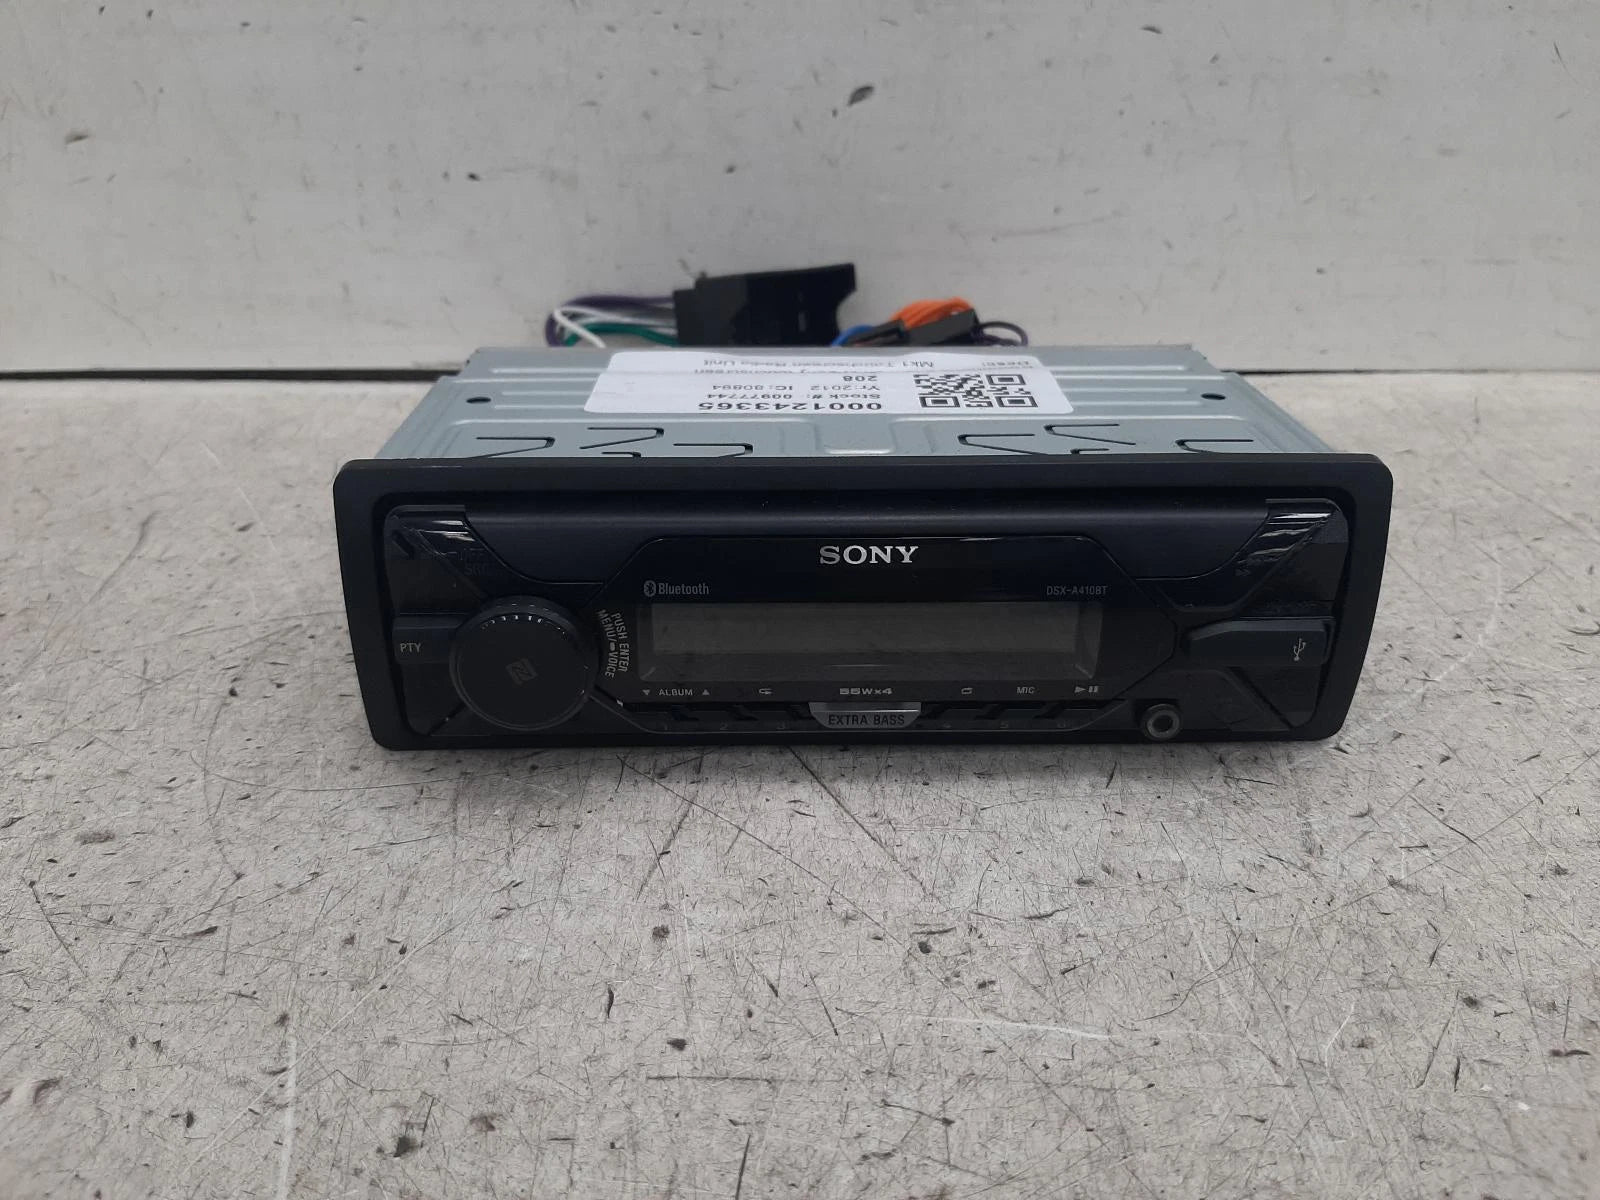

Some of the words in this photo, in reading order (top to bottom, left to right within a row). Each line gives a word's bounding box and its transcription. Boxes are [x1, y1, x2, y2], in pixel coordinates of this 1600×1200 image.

[698, 402, 882, 411] 0001243365
[818, 545, 919, 565] SONY
[658, 582, 710, 595] Bluetooth
[1046, 585, 1108, 596] DSX-A410BT
[611, 612, 628, 639] PUSH
[399, 643, 421, 654] PTY
[617, 642, 630, 673] ENTER
[604, 651, 618, 679] VOICE
[659, 688, 693, 696] ALBUM
[1016, 686, 1036, 694] MIC
[828, 714, 869, 726] EXTRA
[873, 714, 905, 726] BASS
